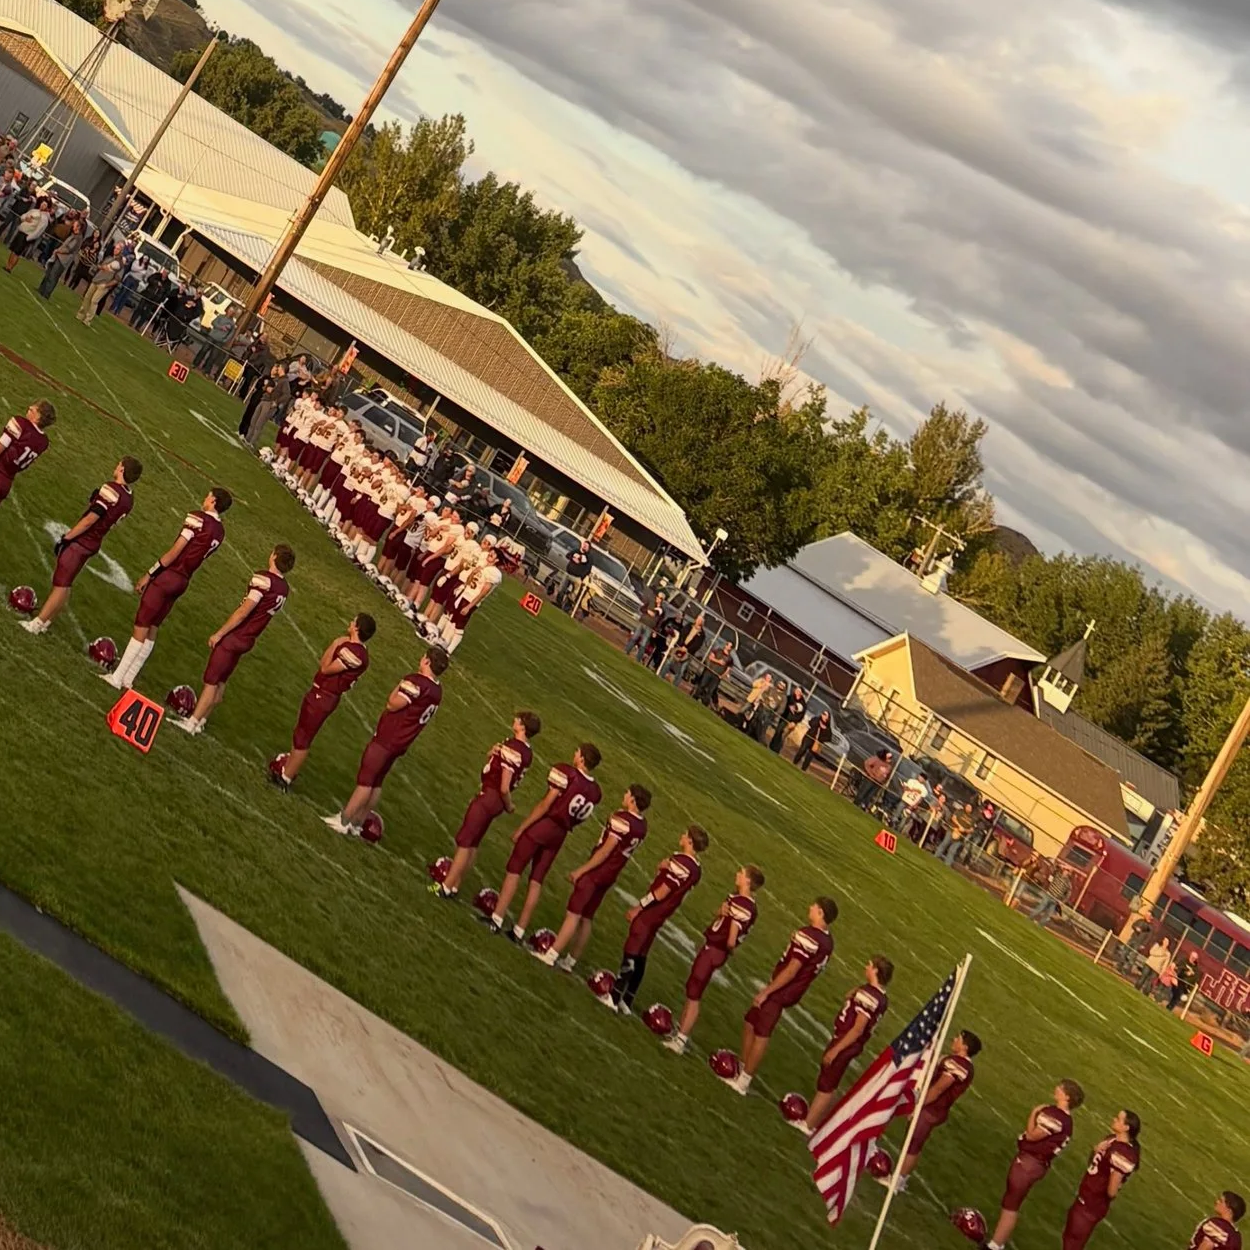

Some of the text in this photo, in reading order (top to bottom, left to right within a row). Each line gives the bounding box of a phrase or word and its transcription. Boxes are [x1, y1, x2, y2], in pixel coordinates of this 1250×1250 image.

[170, 363, 188, 382] 30
[526, 593, 541, 614] 20
[119, 699, 159, 747] 40
[883, 832, 895, 852] 10
